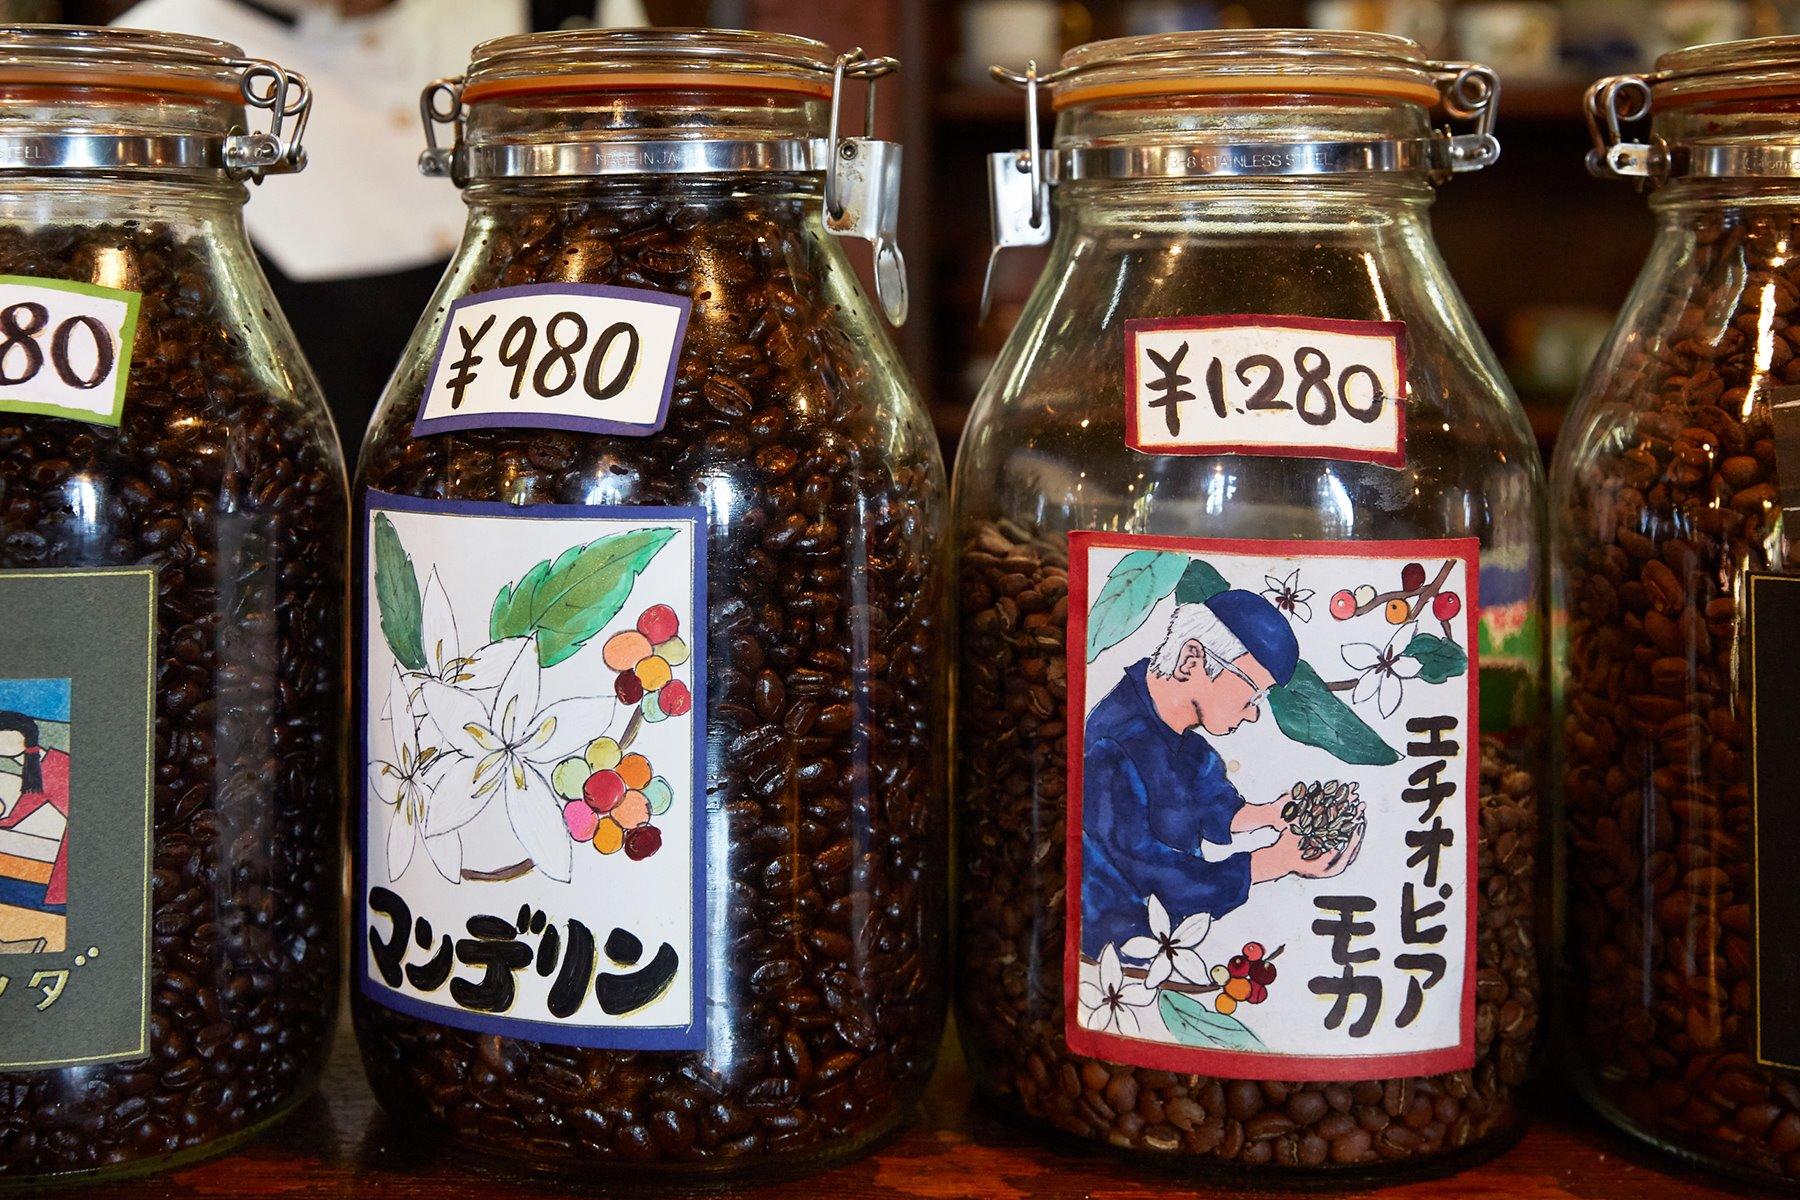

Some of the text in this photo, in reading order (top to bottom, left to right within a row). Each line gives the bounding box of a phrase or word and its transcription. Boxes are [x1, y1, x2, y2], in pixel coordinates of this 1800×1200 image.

[1200, 155, 1282, 169] STAINLESS
[1286, 152, 1333, 167] STEEL
[446, 311, 640, 410] ¥980
[1394, 716, 1460, 1028] エチオピア
[368, 886, 680, 1019] マンデリン
[1307, 895, 1383, 1038] モカ
